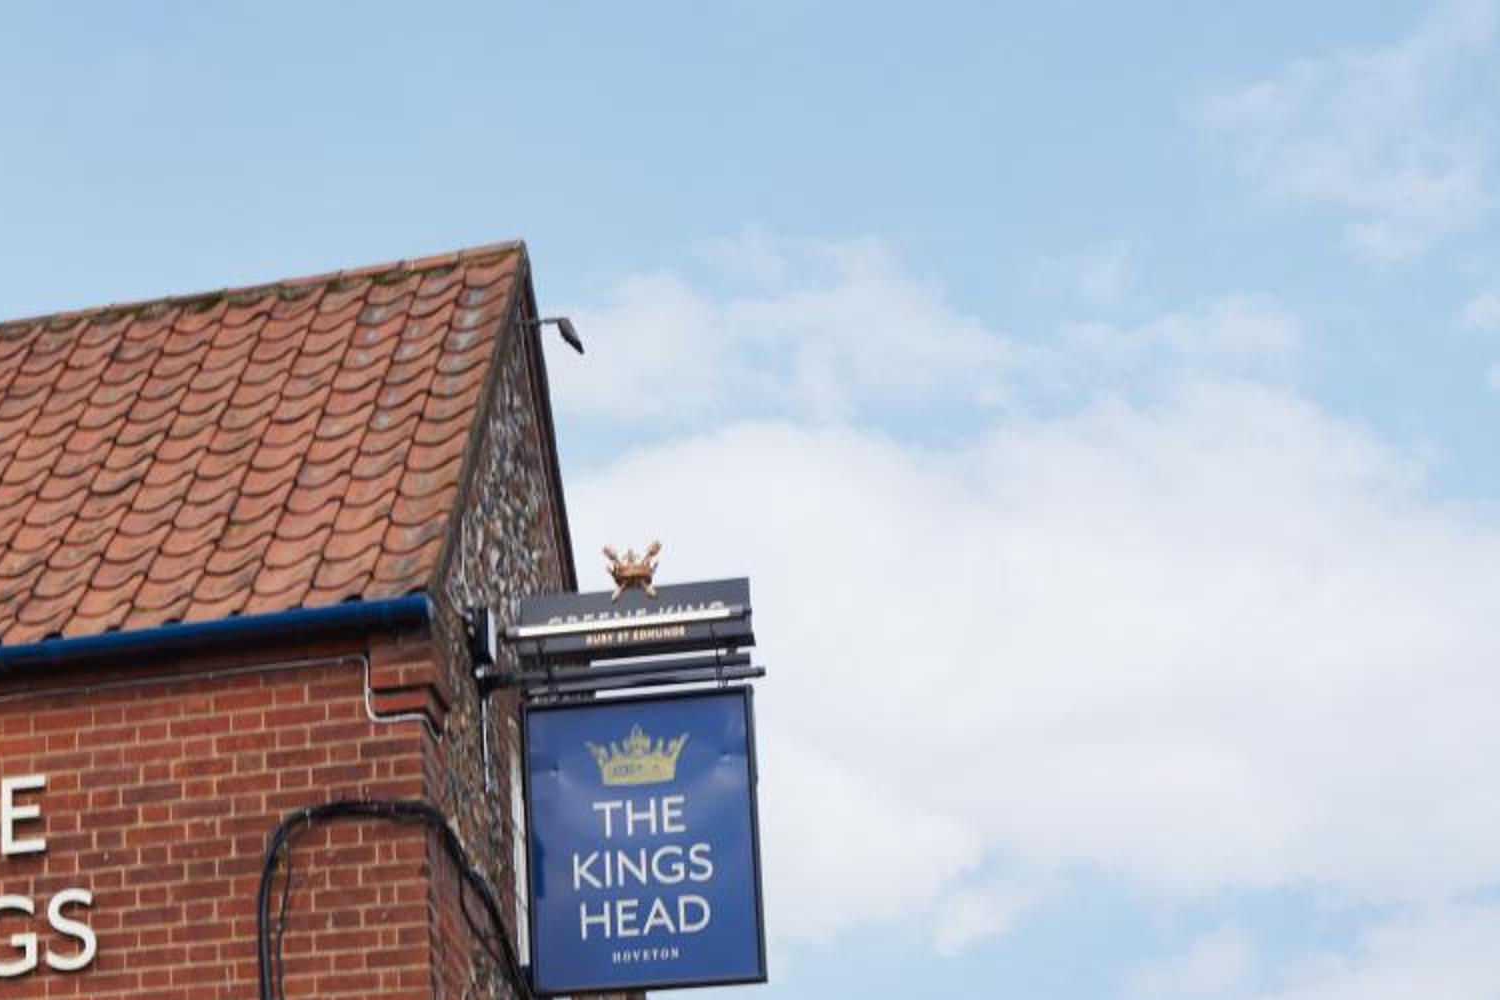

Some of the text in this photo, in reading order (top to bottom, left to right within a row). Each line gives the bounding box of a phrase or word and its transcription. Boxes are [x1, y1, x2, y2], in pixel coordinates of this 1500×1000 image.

[592, 795, 686, 838] THE
[573, 843, 713, 890] KINGS
[580, 894, 711, 940] HEAD
[612, 947, 679, 964] HOVETON
